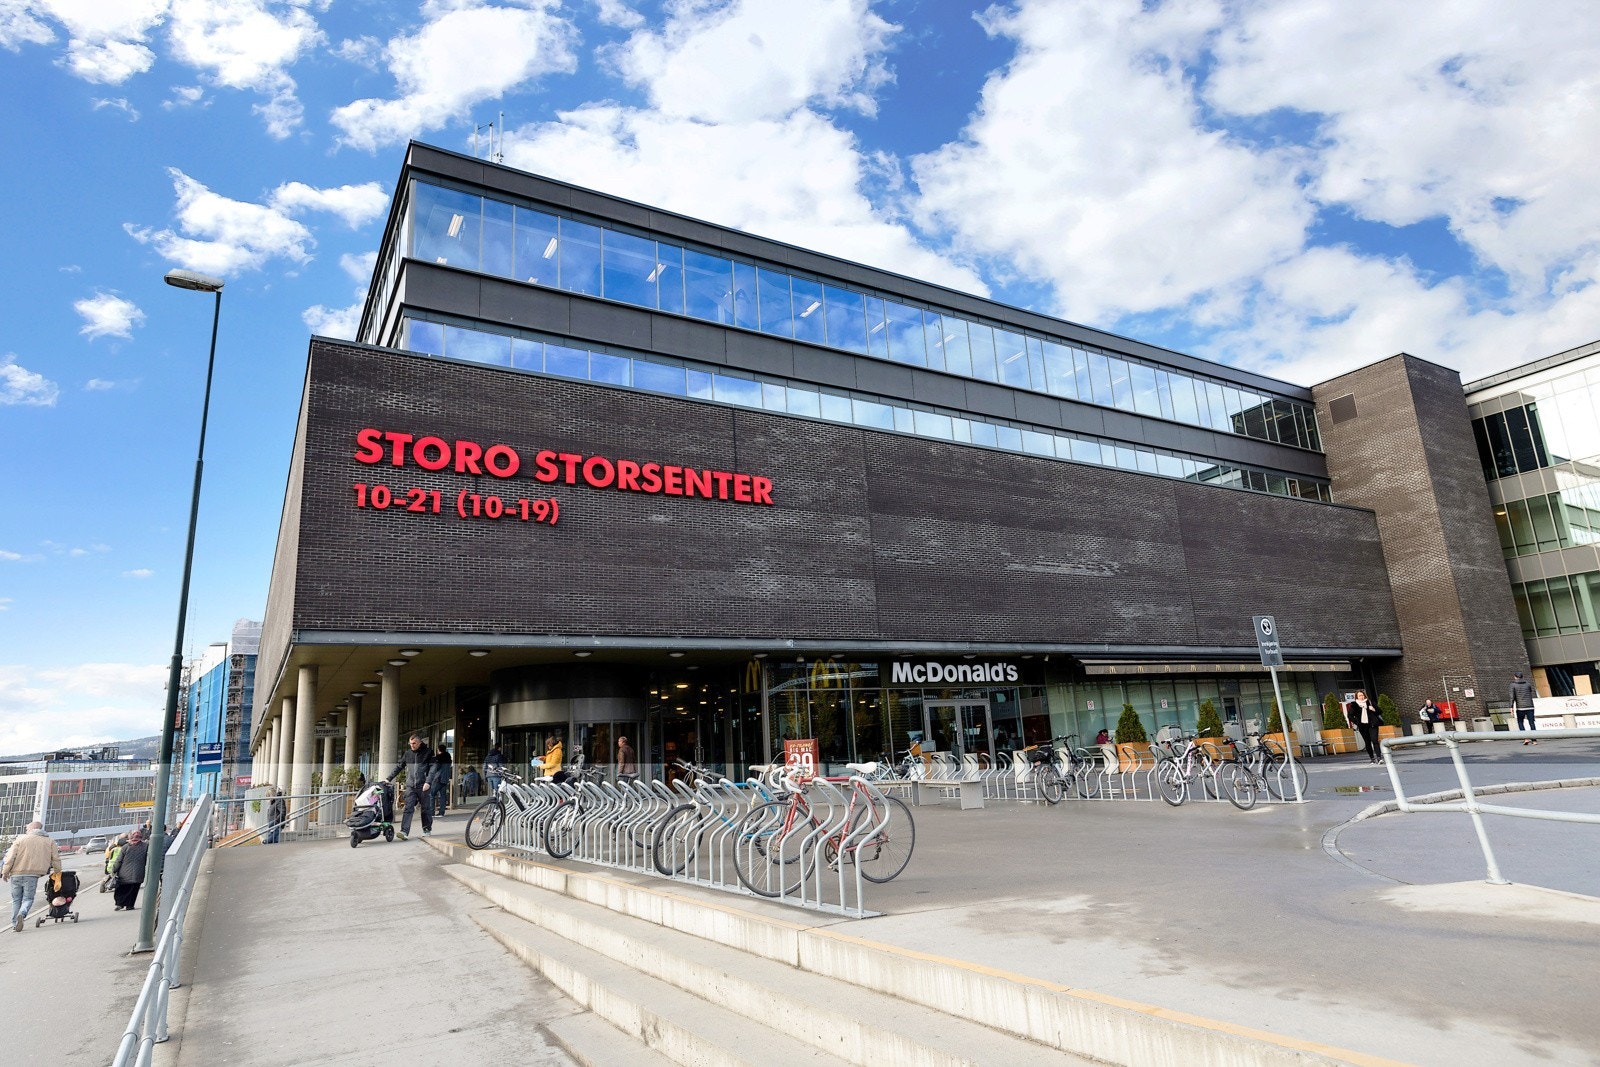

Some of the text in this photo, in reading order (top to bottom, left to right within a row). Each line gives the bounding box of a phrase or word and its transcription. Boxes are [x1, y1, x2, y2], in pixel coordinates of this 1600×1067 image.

[353, 428, 774, 505] STORO STORSENTER
[353, 484, 560, 525] 10-21 (10-19)
[892, 662, 1019, 683] McDonald's
